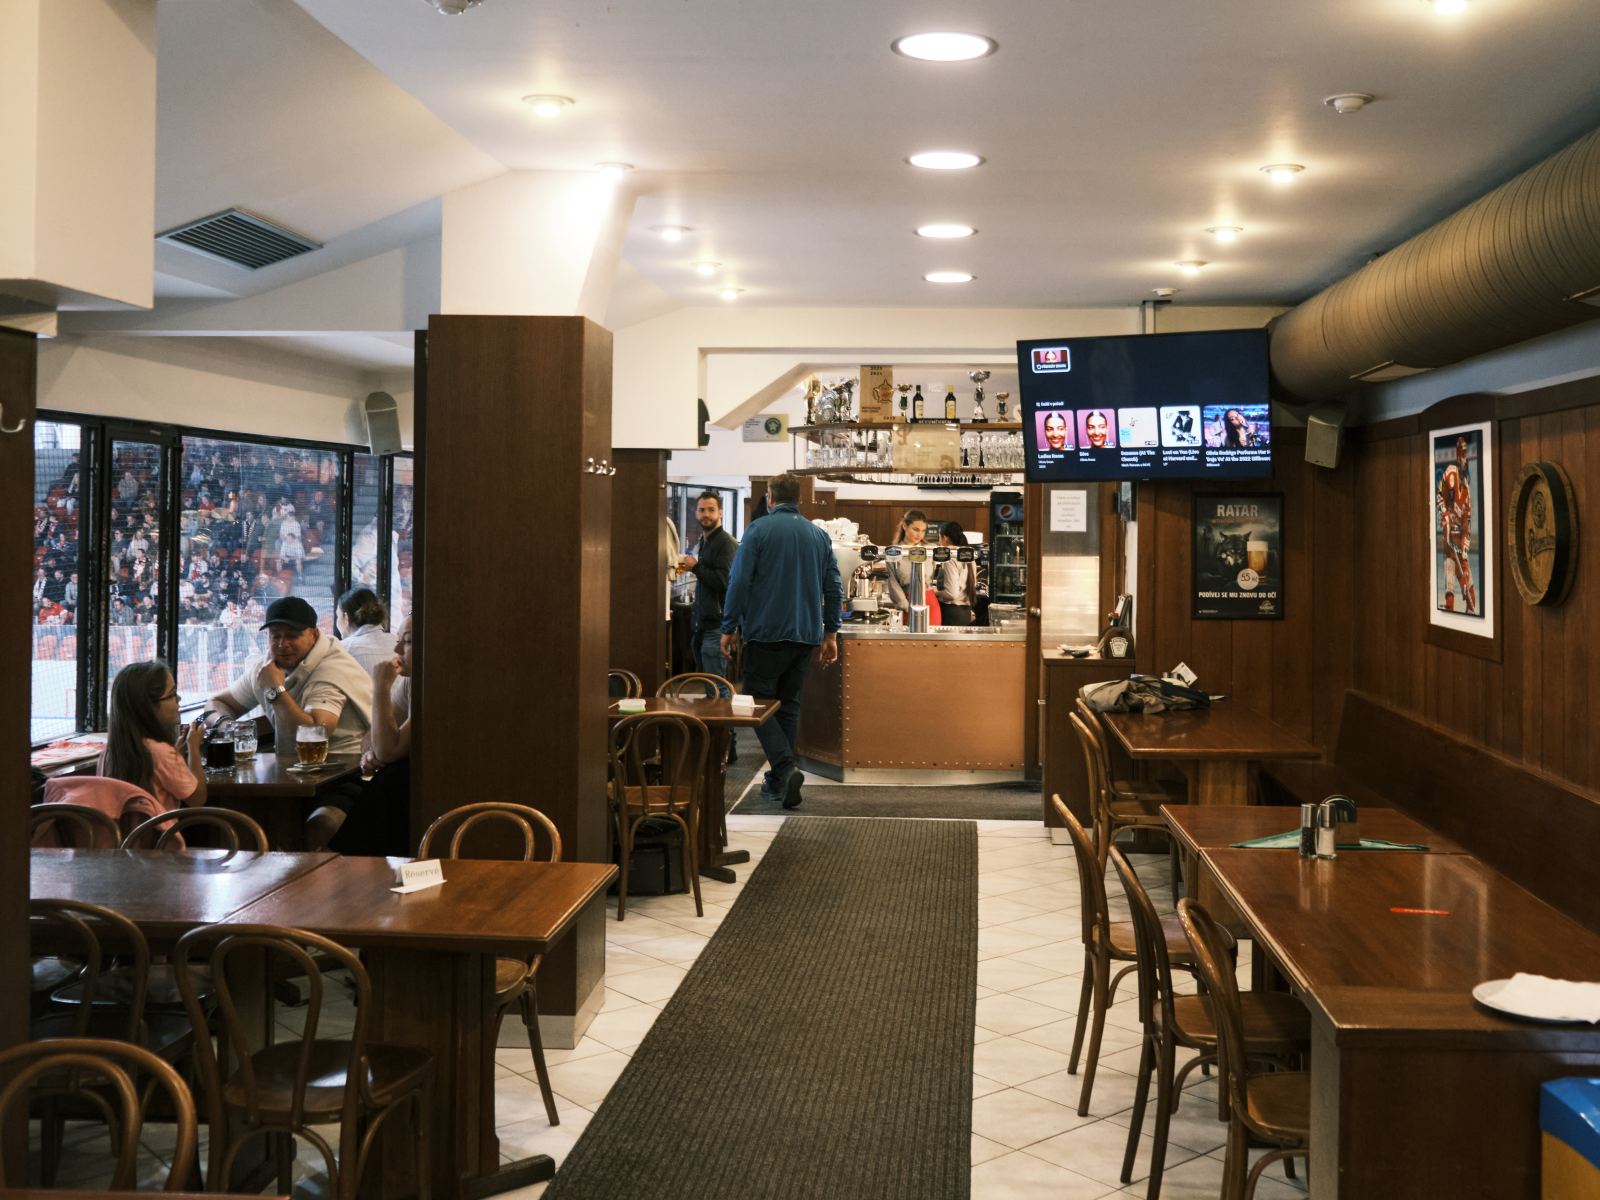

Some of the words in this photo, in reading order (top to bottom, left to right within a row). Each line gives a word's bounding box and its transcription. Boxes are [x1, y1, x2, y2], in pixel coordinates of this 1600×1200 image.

[1217, 504, 1258, 517] RATAR
[1241, 572, 1251, 582] 55
[1198, 590, 1221, 598] PODÍVEJ
[1239, 591, 1258, 599] ZNOVU
